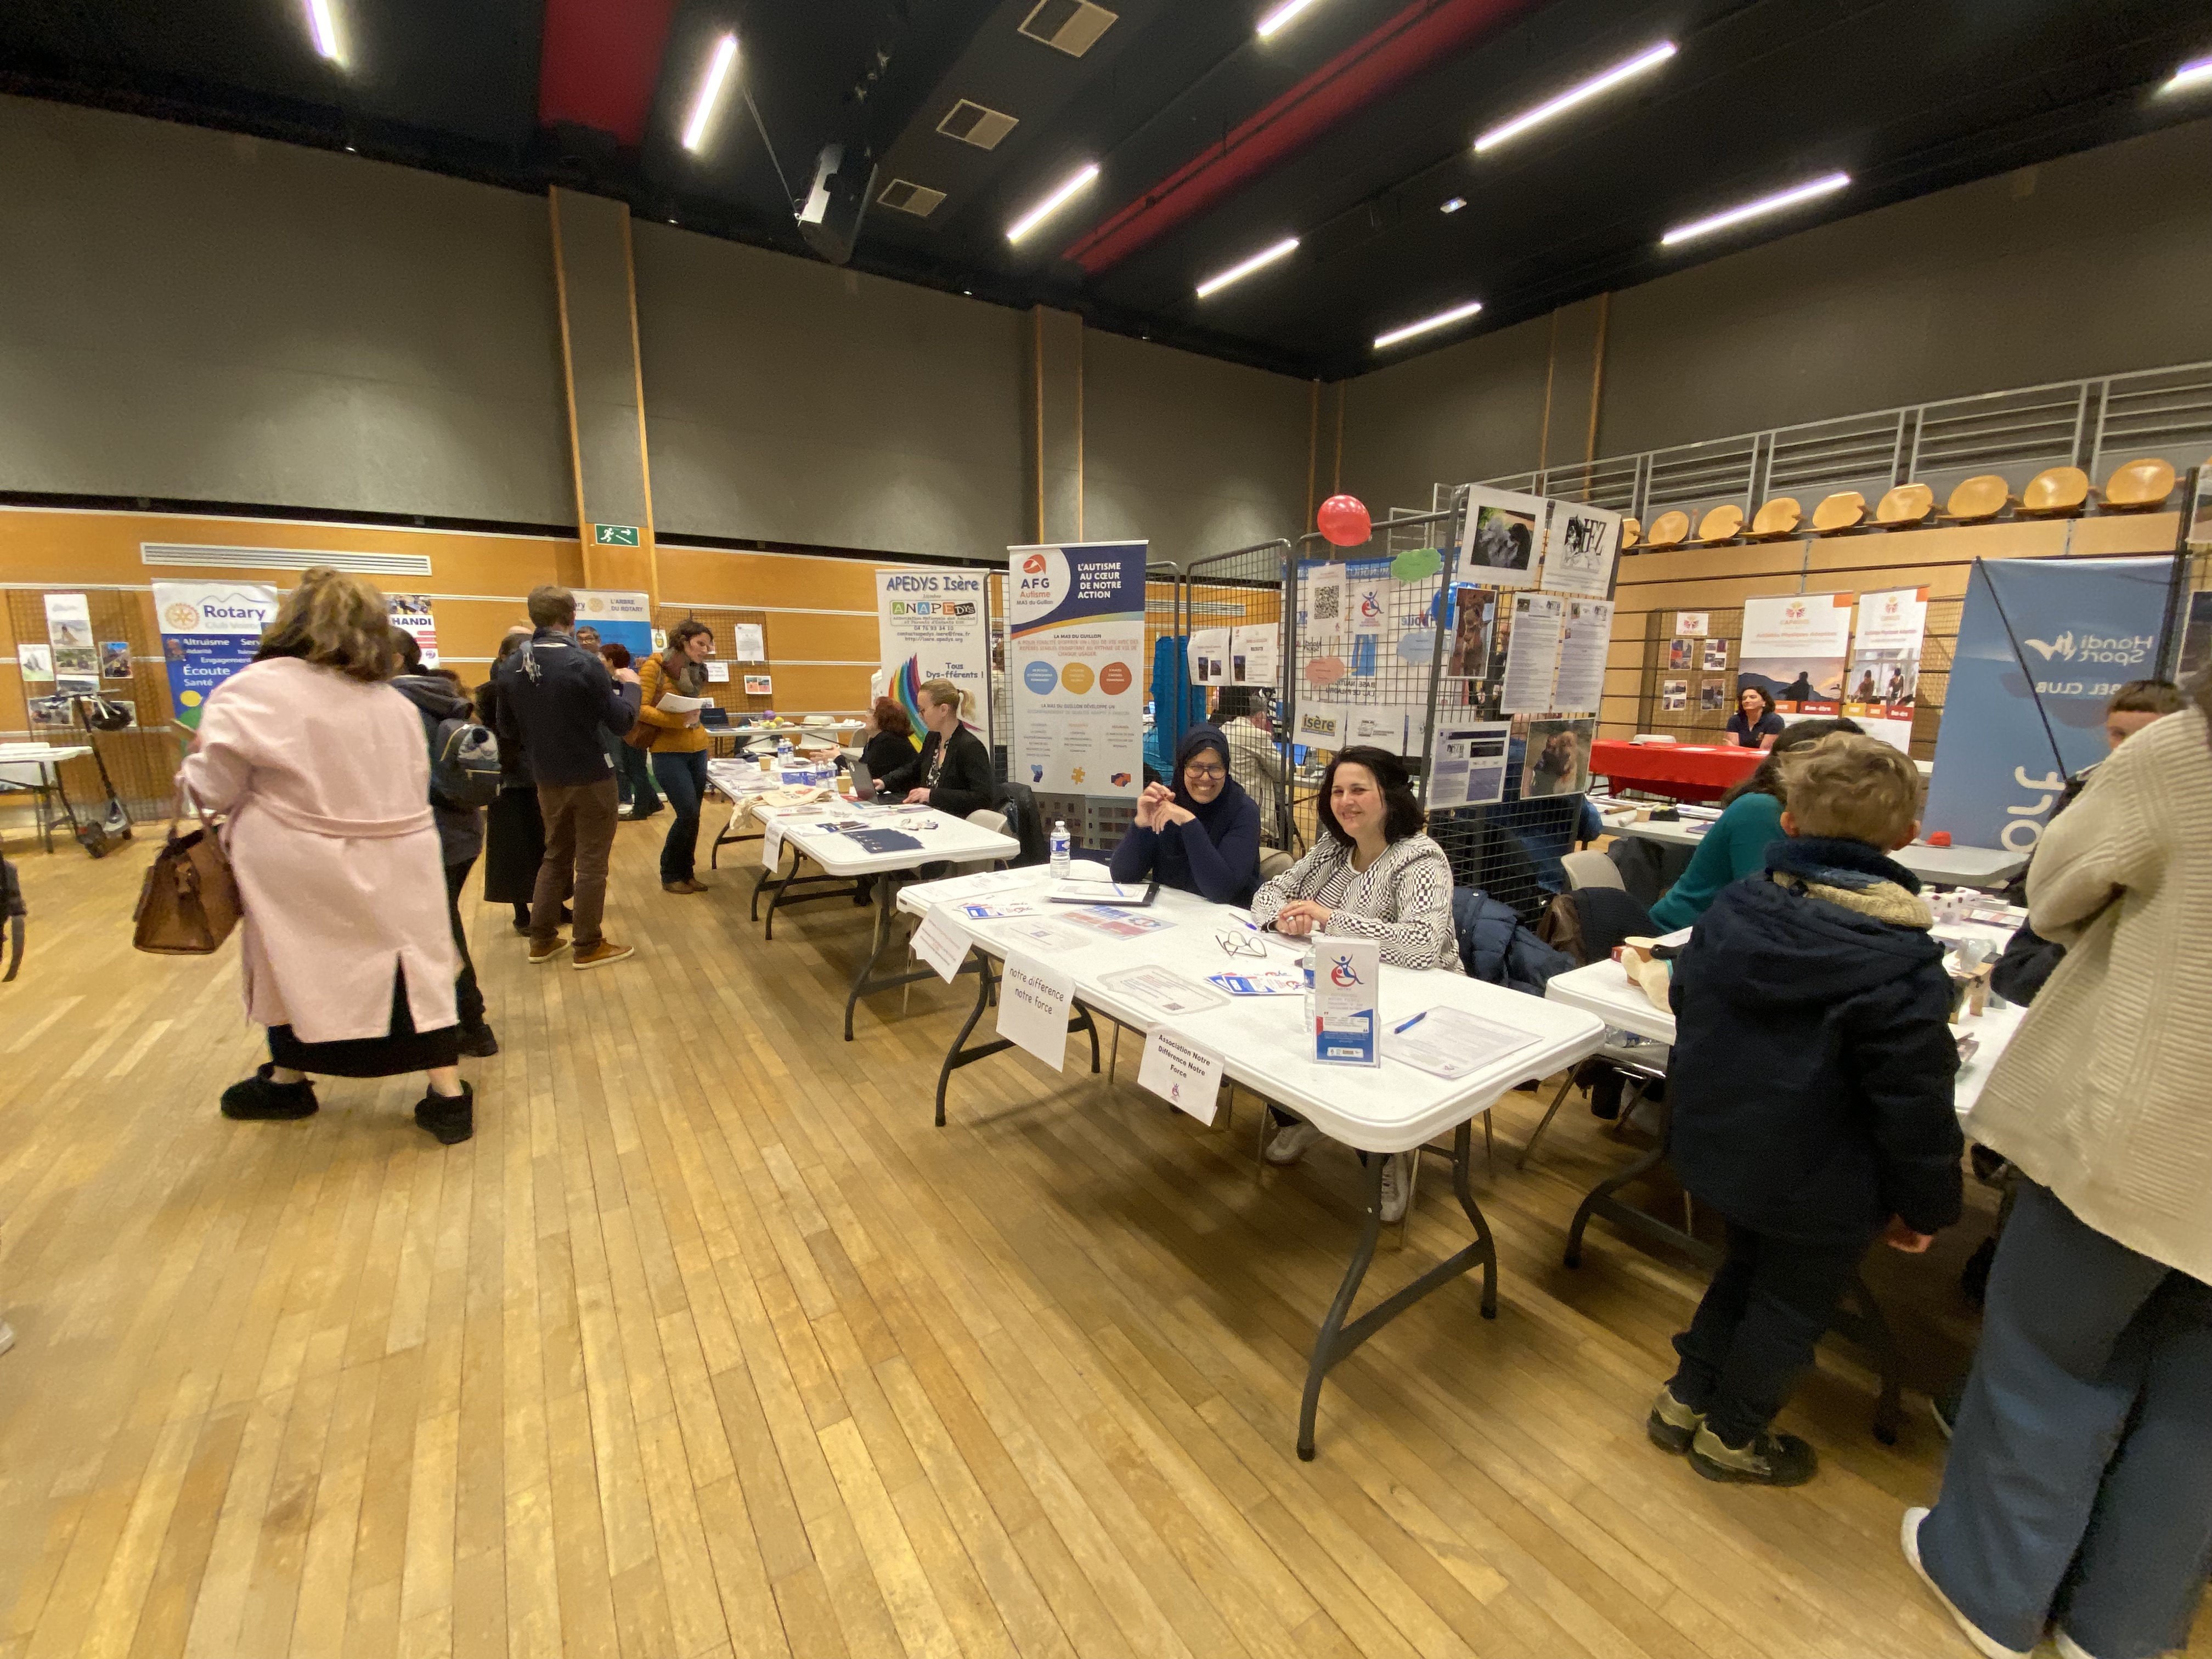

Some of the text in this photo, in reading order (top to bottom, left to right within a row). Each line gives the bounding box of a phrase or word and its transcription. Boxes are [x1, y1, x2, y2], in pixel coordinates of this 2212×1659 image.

[1077, 562, 1121, 571] L'AUTISME
[1094, 572, 1120, 580] CŒUR
[887, 575, 979, 591] APEDYS Isère
[1020, 578, 1050, 589] AFG
[1093, 581, 1121, 589] NOTRE
[1077, 591, 1111, 599] ACTION
[204, 605, 266, 620] Rotary
[183, 664, 230, 675] Écoute
[926, 670, 978, 679] Dys-fférents
[184, 679, 213, 687] Santé
[1304, 714, 1334, 731] isère
[1009, 968, 1026, 982] notre
[1015, 988, 1052, 1014] notre force
[1159, 1034, 1210, 1066] Association Notre
[1158, 1046, 1205, 1076] Différence Notre
[1170, 1064, 1187, 1078] Force
